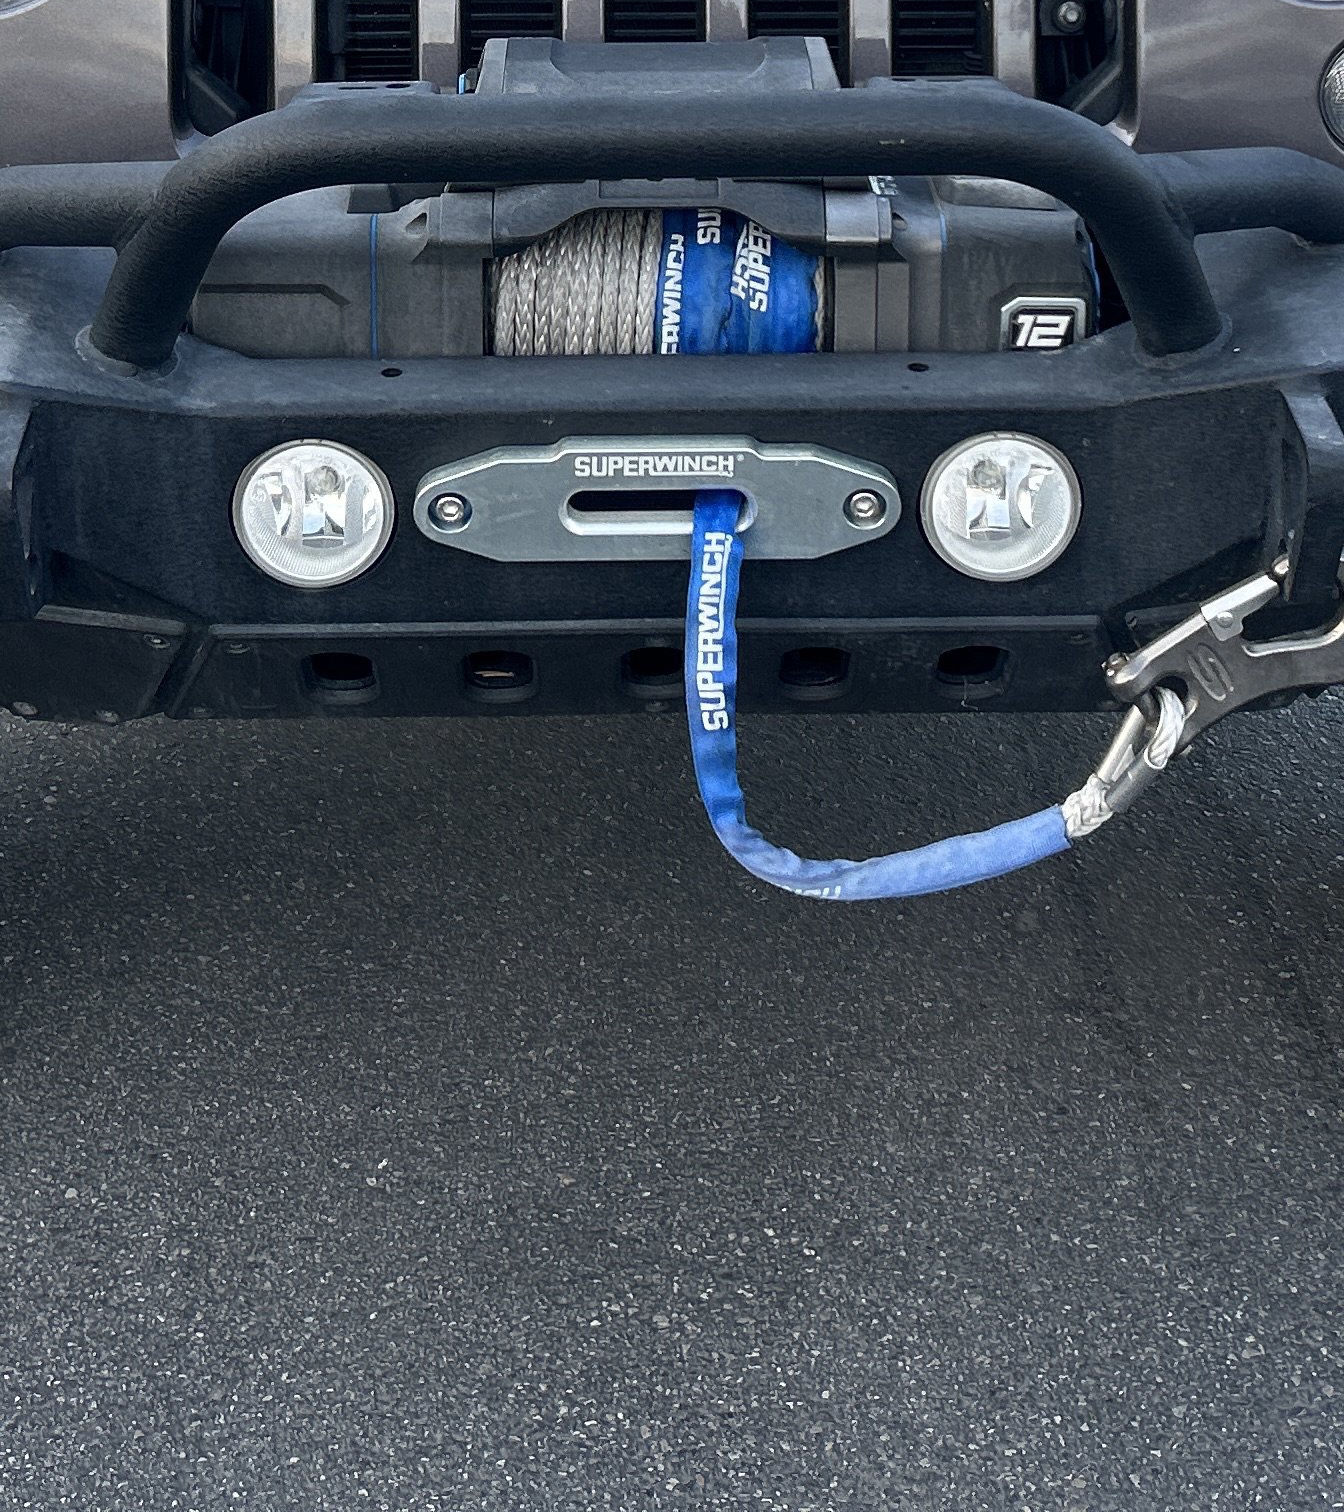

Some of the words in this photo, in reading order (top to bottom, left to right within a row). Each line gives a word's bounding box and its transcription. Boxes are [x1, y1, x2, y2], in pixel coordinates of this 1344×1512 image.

[697, 209, 722, 245] SU
[1016, 315, 1072, 347] 12
[574, 454, 734, 477] SUPERWINCH
[696, 531, 730, 731] SUPERWINCH
